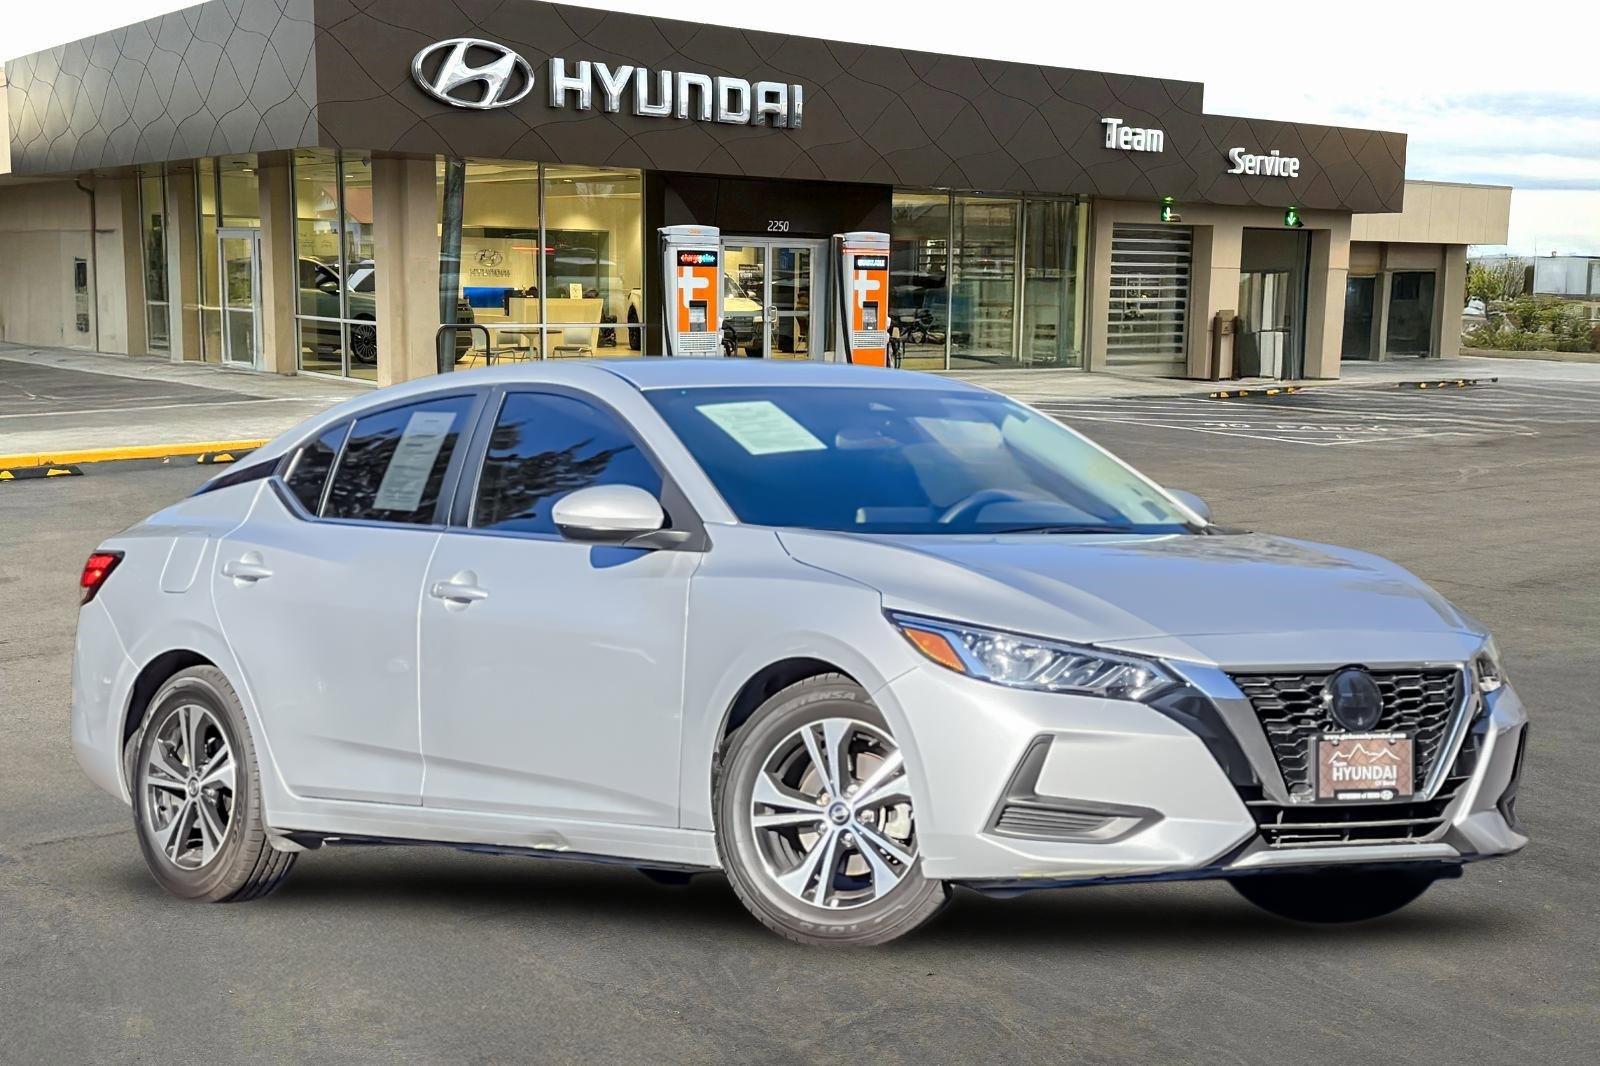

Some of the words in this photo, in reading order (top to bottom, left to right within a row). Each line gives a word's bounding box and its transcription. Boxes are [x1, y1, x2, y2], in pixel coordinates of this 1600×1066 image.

[548, 57, 803, 130] HYUNDAI
[1101, 117, 1164, 152] Team
[1227, 147, 1300, 178] Service
[767, 220, 790, 232] 2250
[1332, 764, 1397, 781] HYUNDAI
